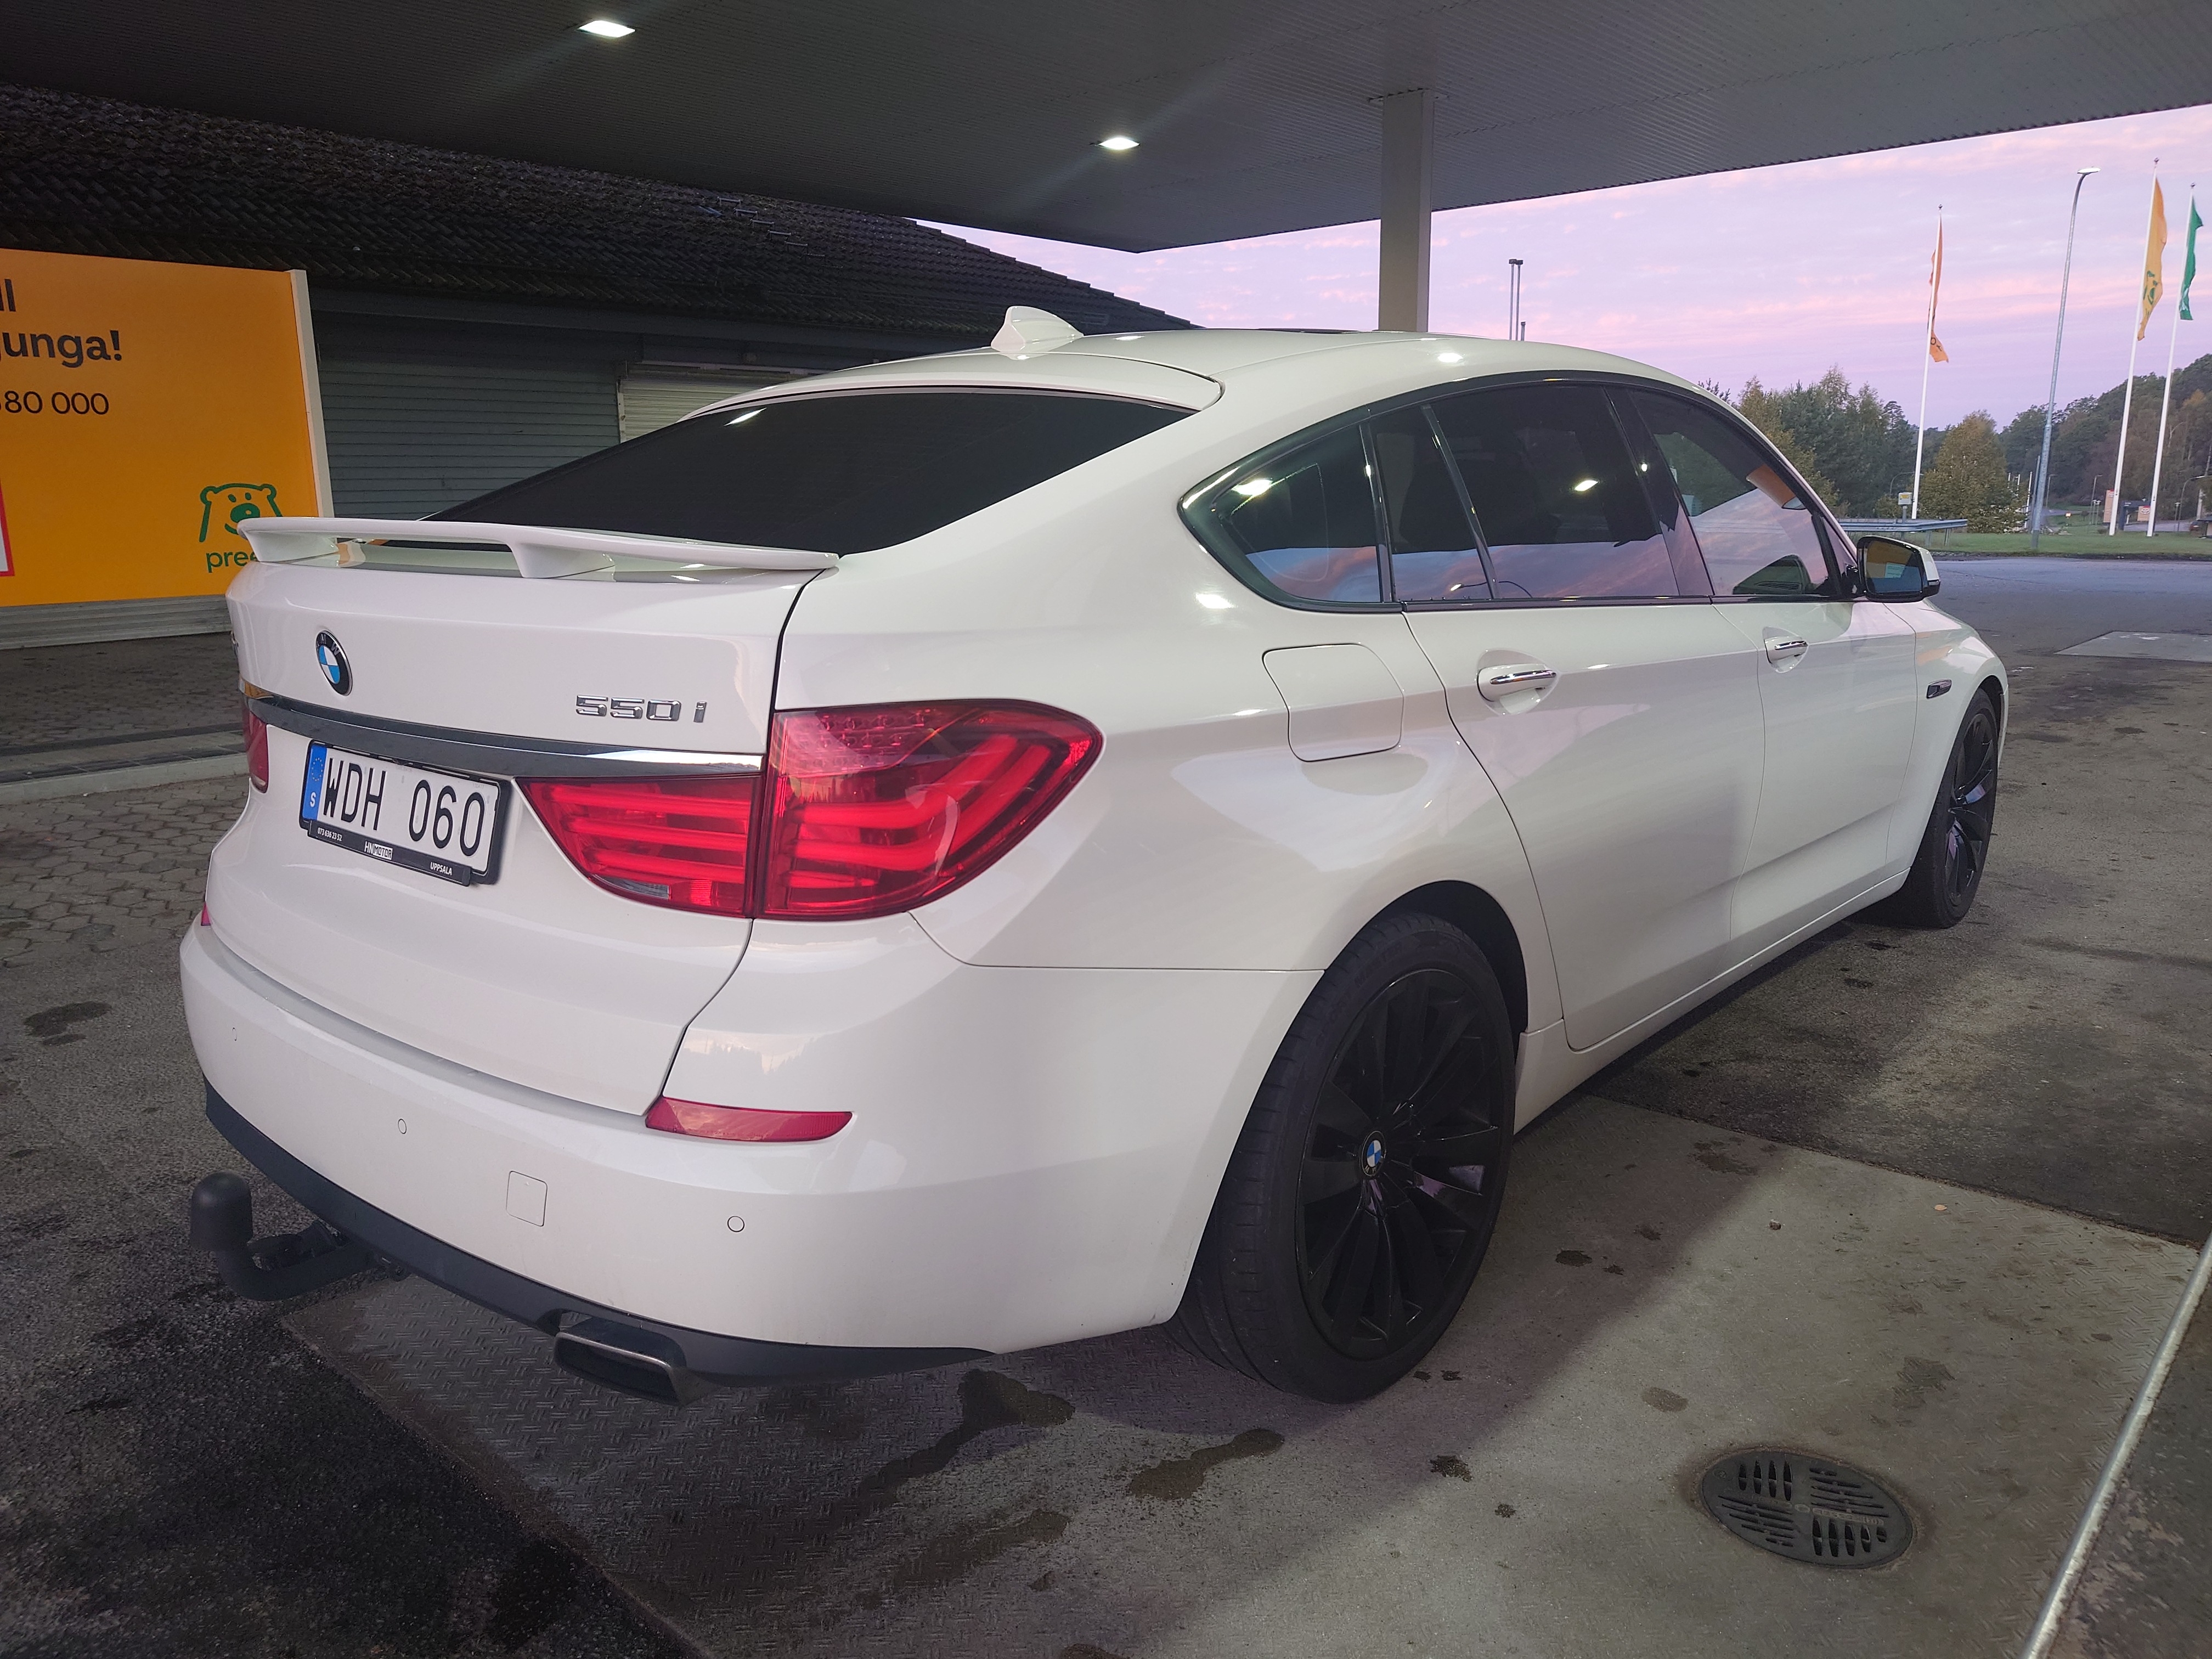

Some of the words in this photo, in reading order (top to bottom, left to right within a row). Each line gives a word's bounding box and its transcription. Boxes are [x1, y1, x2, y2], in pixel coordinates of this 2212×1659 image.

[0, 330, 122, 368] unga!
[0, 390, 43, 414] 80
[51, 392, 109, 415] 000
[310, 792, 317, 807] S
[323, 758, 386, 831] WDH
[409, 780, 485, 856] 060
[431, 862, 452, 875] UPPSALA
